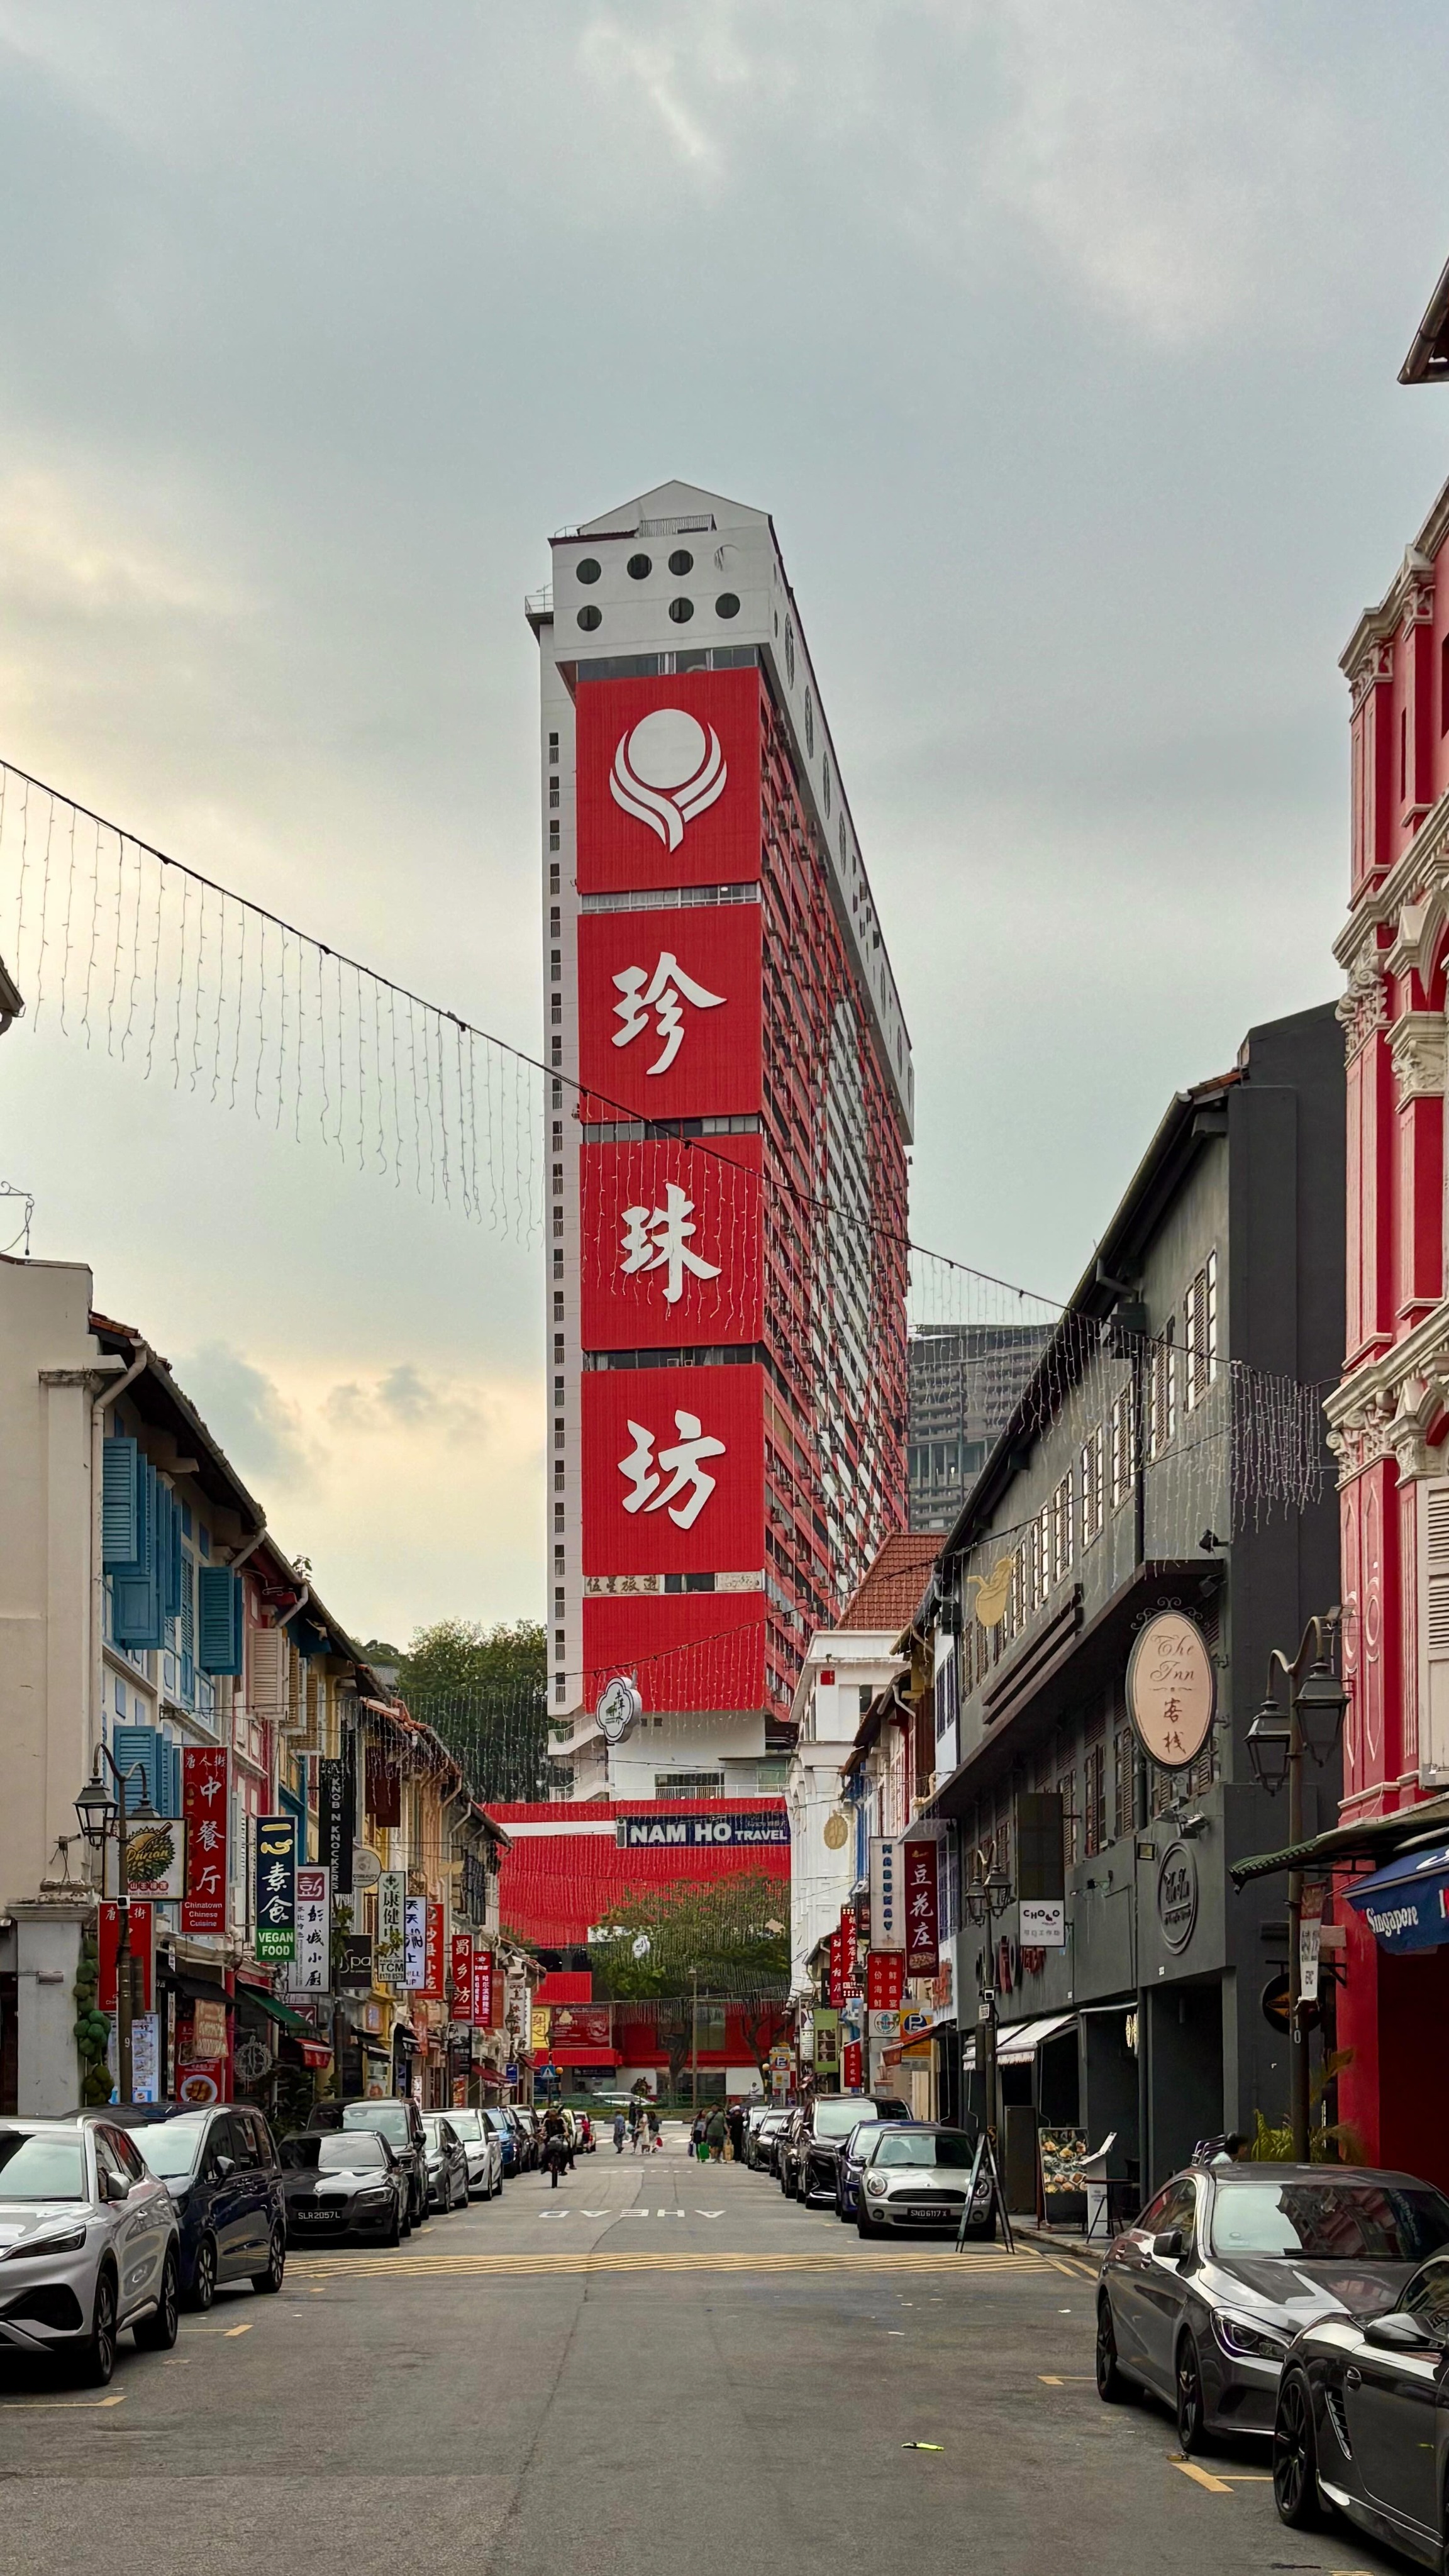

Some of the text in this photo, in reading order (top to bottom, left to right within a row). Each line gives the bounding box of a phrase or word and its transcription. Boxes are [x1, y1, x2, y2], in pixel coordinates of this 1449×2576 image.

[1150, 1635, 1196, 1657] The
[1149, 1660, 1194, 1682] Inn
[195, 1775, 225, 1895] 中餐厅
[631, 1823, 787, 1843] NAM HO TRAVEL
[331, 1826, 340, 1890] KNOCKERS
[259, 1823, 294, 1923] 一心素食
[106, 1906, 146, 1920] 唐街
[910, 1863, 934, 1948] 豆花庄
[1366, 1906, 1419, 1938] Singapore
[258, 1932, 294, 1943] VEGAN
[262, 1945, 290, 1956] FOOD
[379, 1963, 404, 1973] TCM
[298, 2211, 341, 2219] SLR2057L
[538, 2209, 726, 2218] AHEAD
